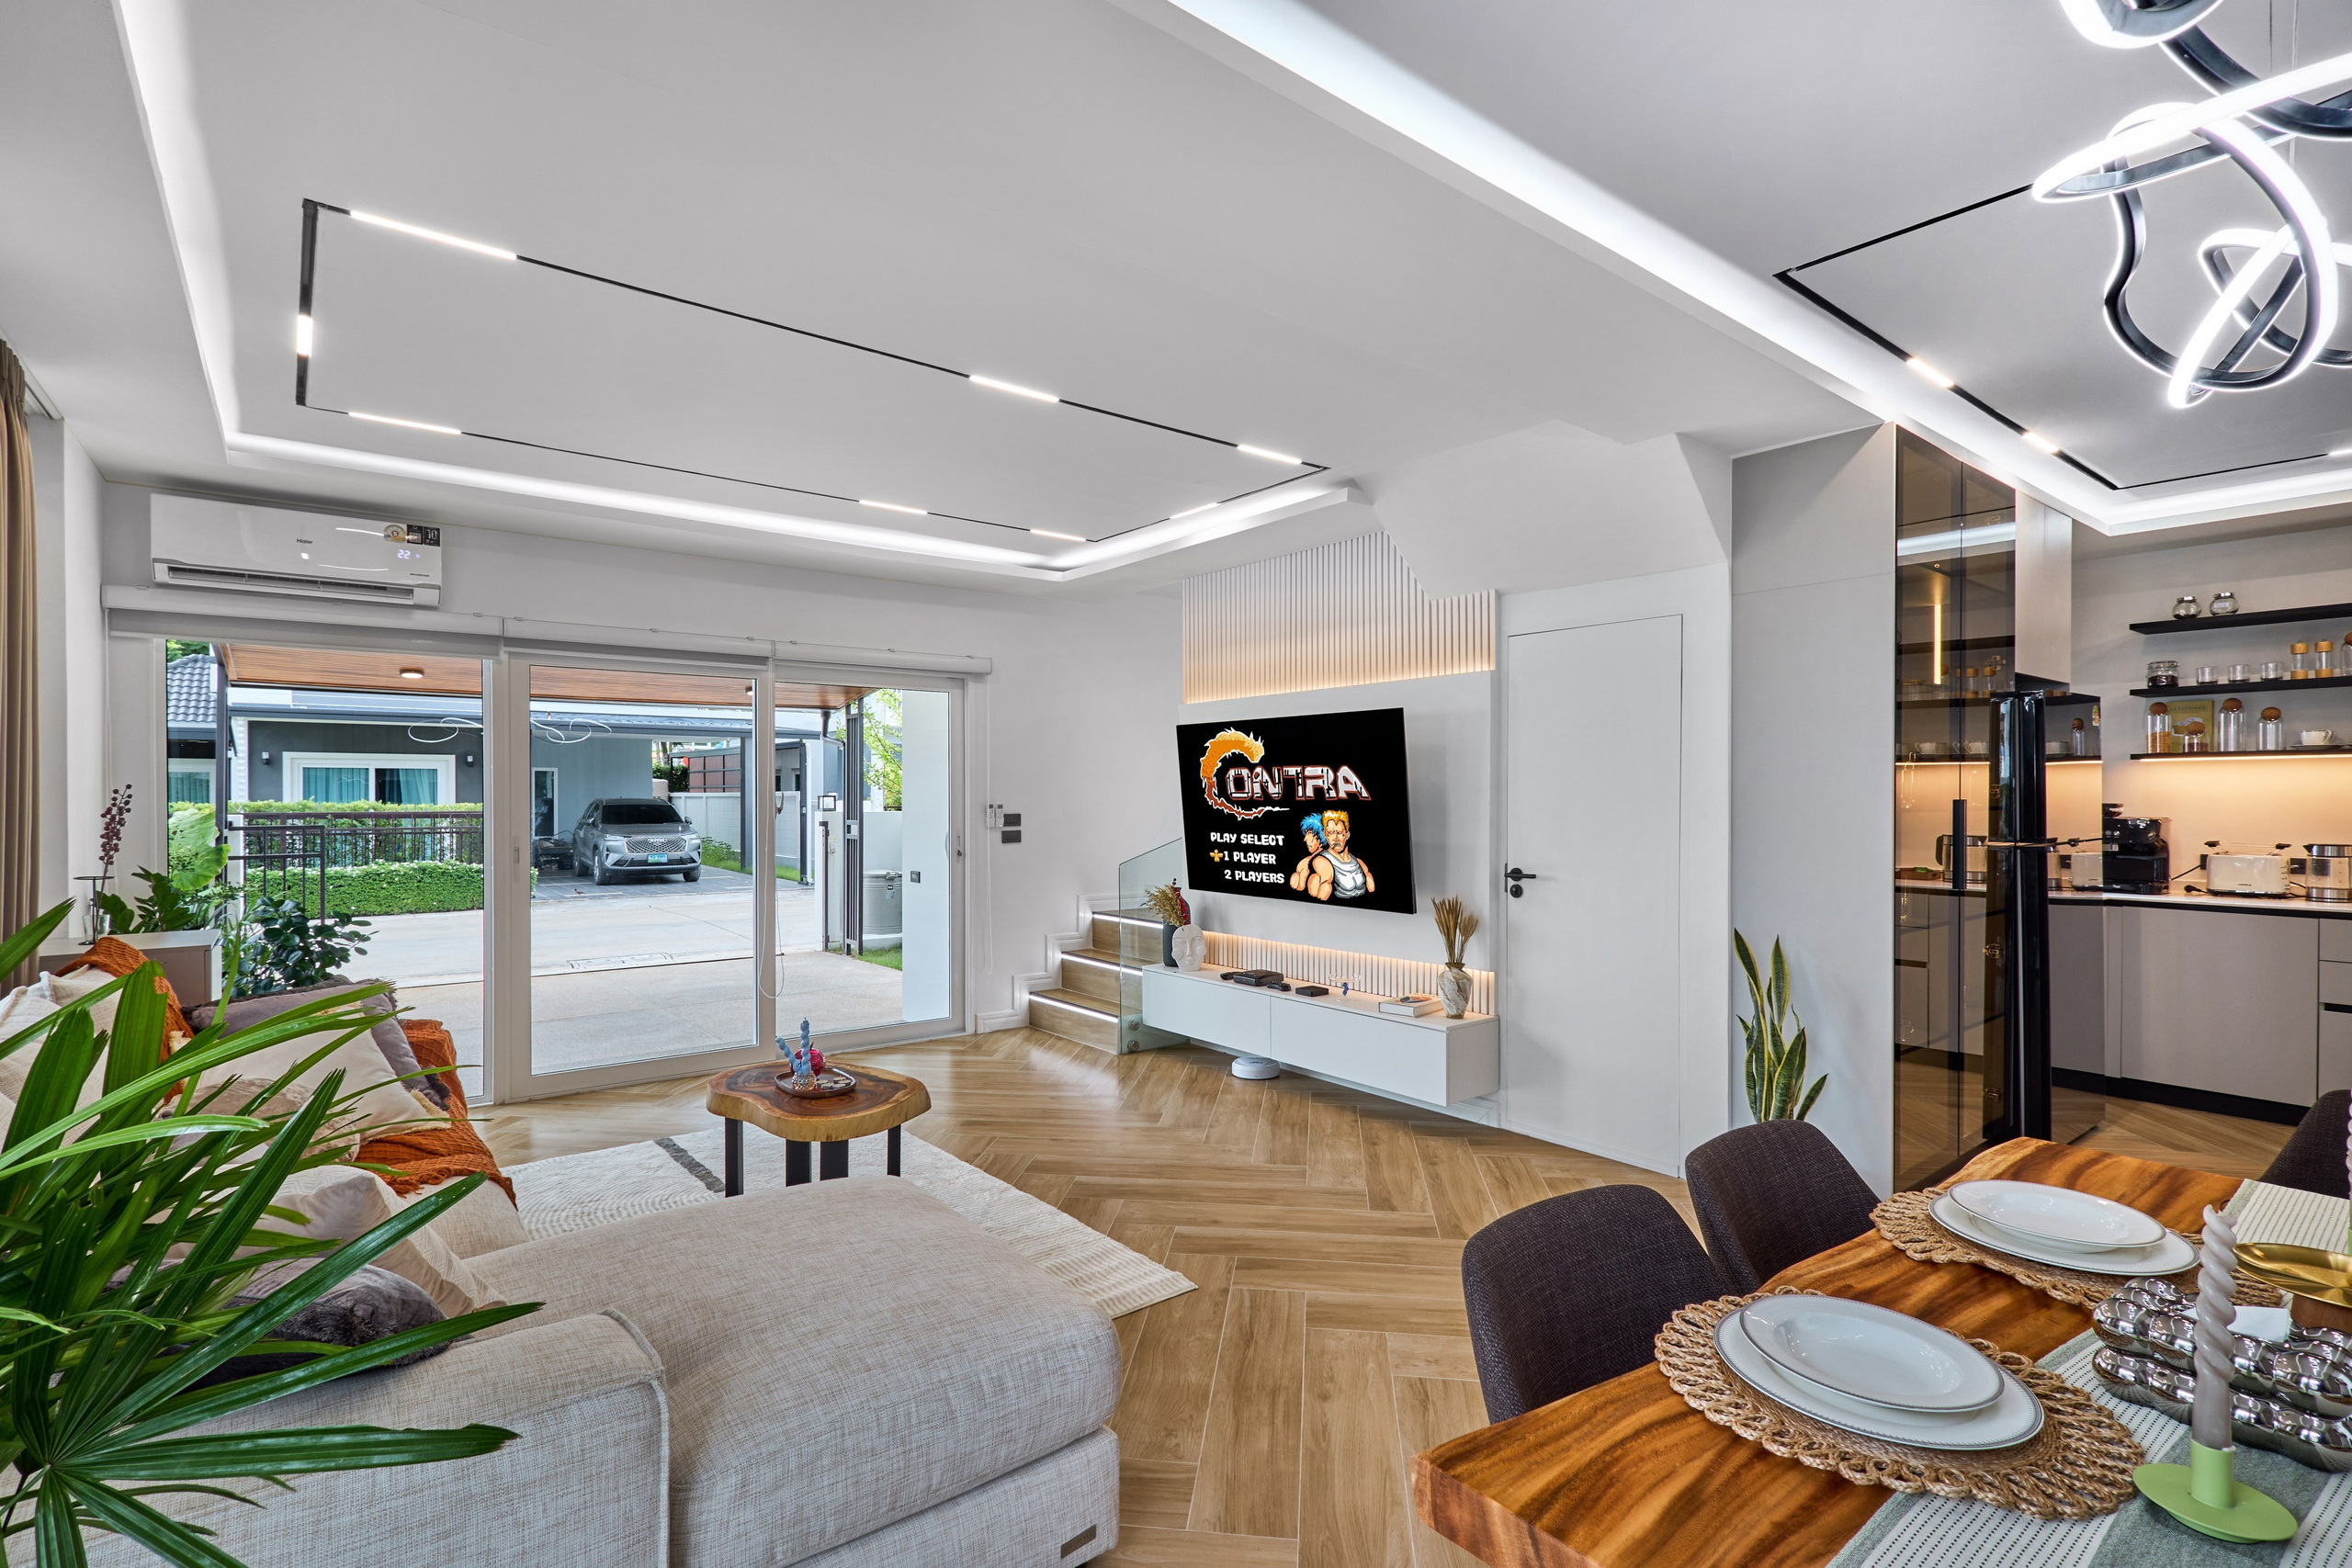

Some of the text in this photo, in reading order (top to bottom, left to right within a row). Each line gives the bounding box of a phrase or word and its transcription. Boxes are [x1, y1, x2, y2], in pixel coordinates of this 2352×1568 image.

[426, 528, 437, 540] 10
[397, 548, 411, 559] 22
[1200, 727, 1372, 821] CONTRA
[1210, 831, 1284, 846] PLAY SELECT
[1223, 851, 1276, 864] 1 PLAYER
[1224, 869, 1284, 884] 2 PLAYERS
